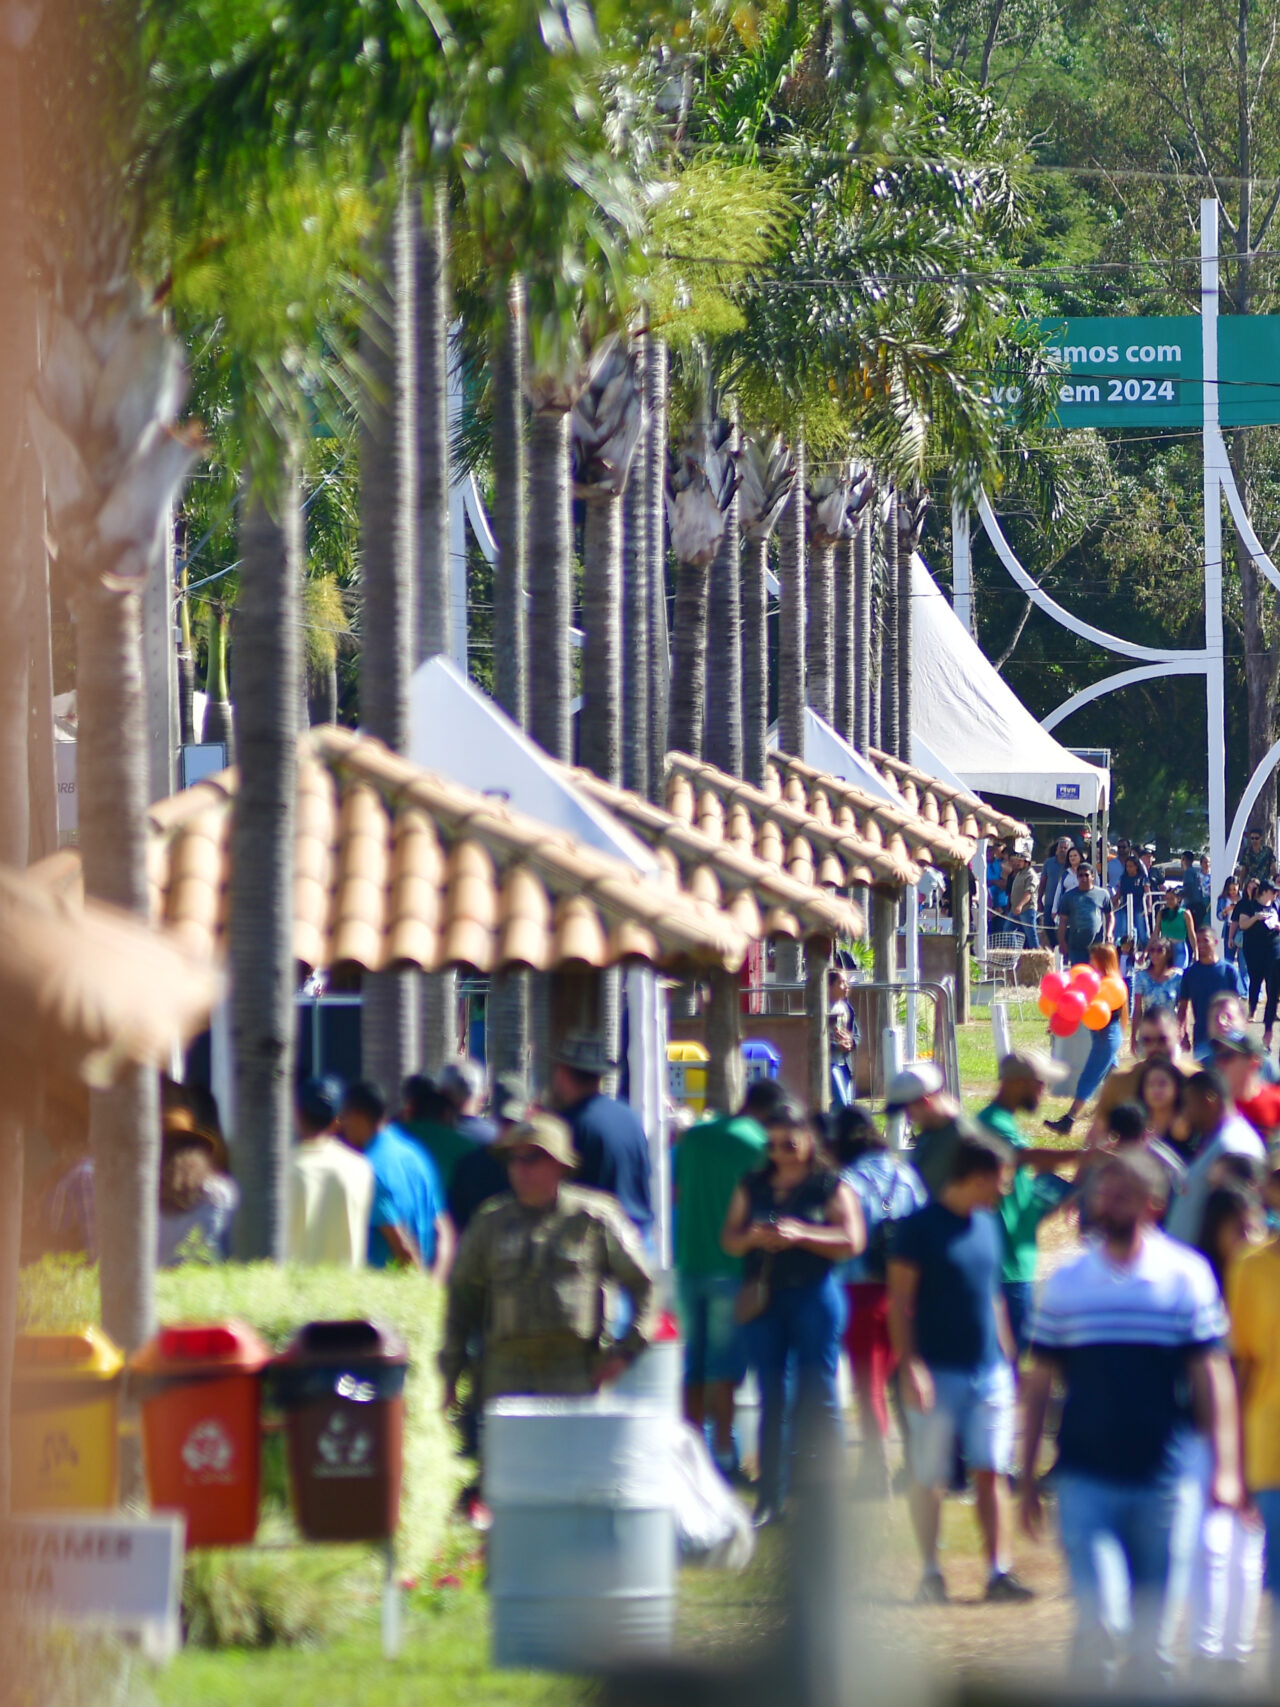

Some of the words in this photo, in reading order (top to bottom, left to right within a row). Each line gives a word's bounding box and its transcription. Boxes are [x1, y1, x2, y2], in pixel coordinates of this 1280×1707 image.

[1126, 344, 1182, 362] com
[1060, 385, 1100, 402] em
[1107, 379, 1175, 402] 2024
